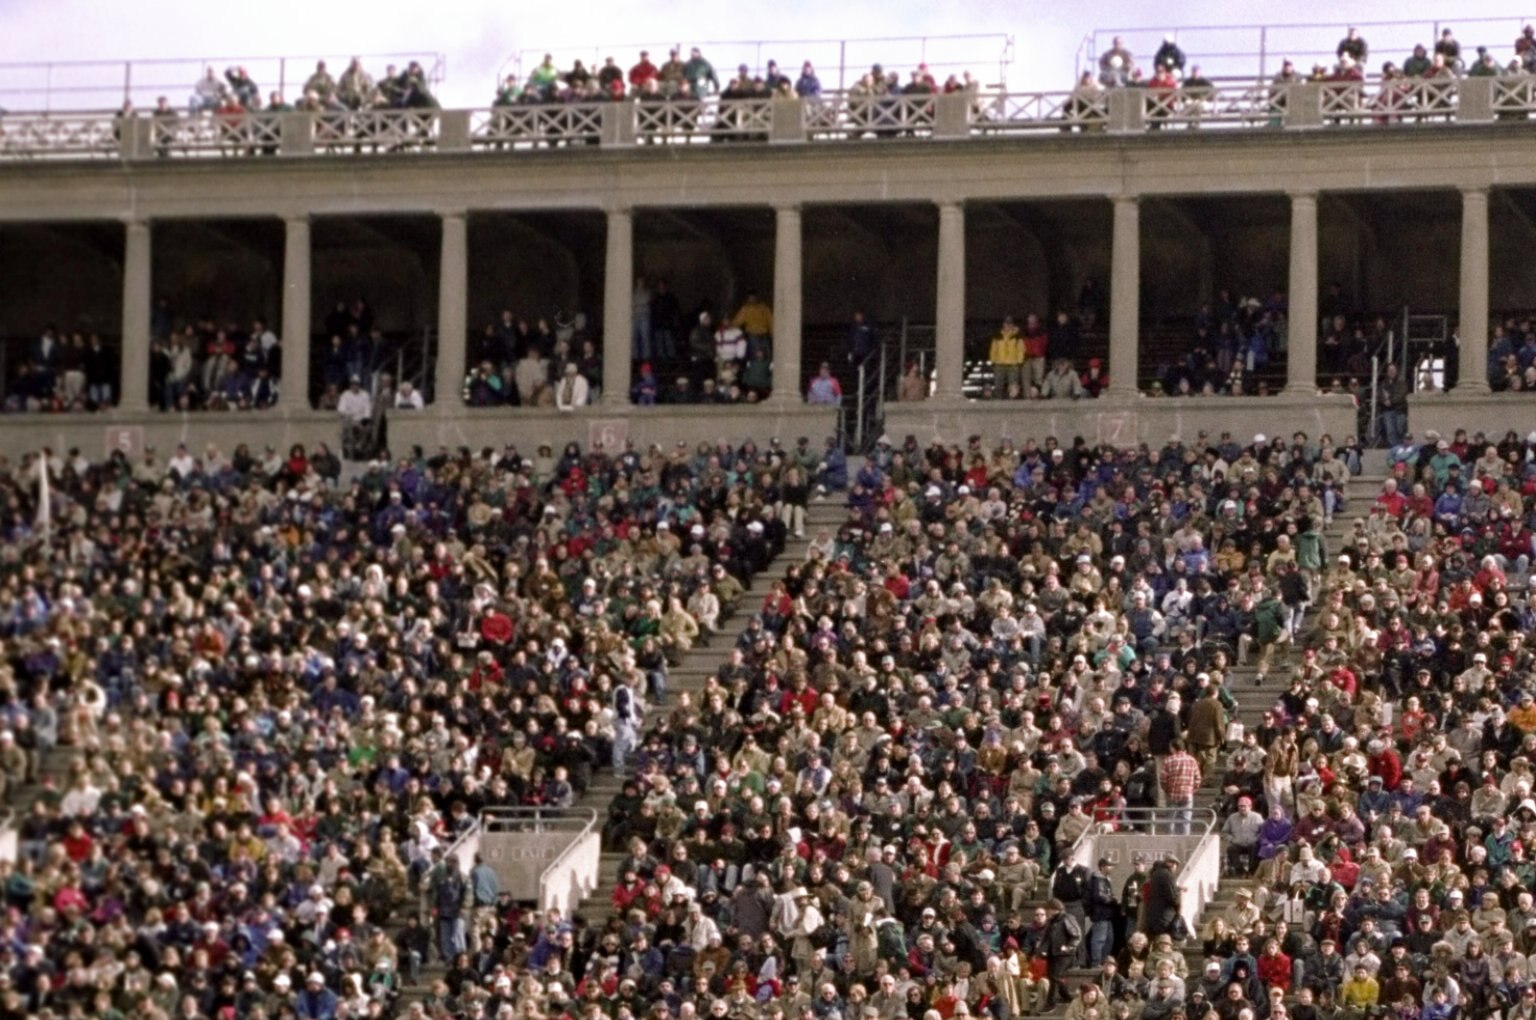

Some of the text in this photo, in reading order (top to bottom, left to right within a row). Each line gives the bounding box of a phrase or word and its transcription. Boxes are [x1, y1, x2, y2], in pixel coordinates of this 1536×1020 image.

[601, 426, 616, 447] 6
[1111, 419, 1124, 440] 7
[119, 431, 131, 452] 5
